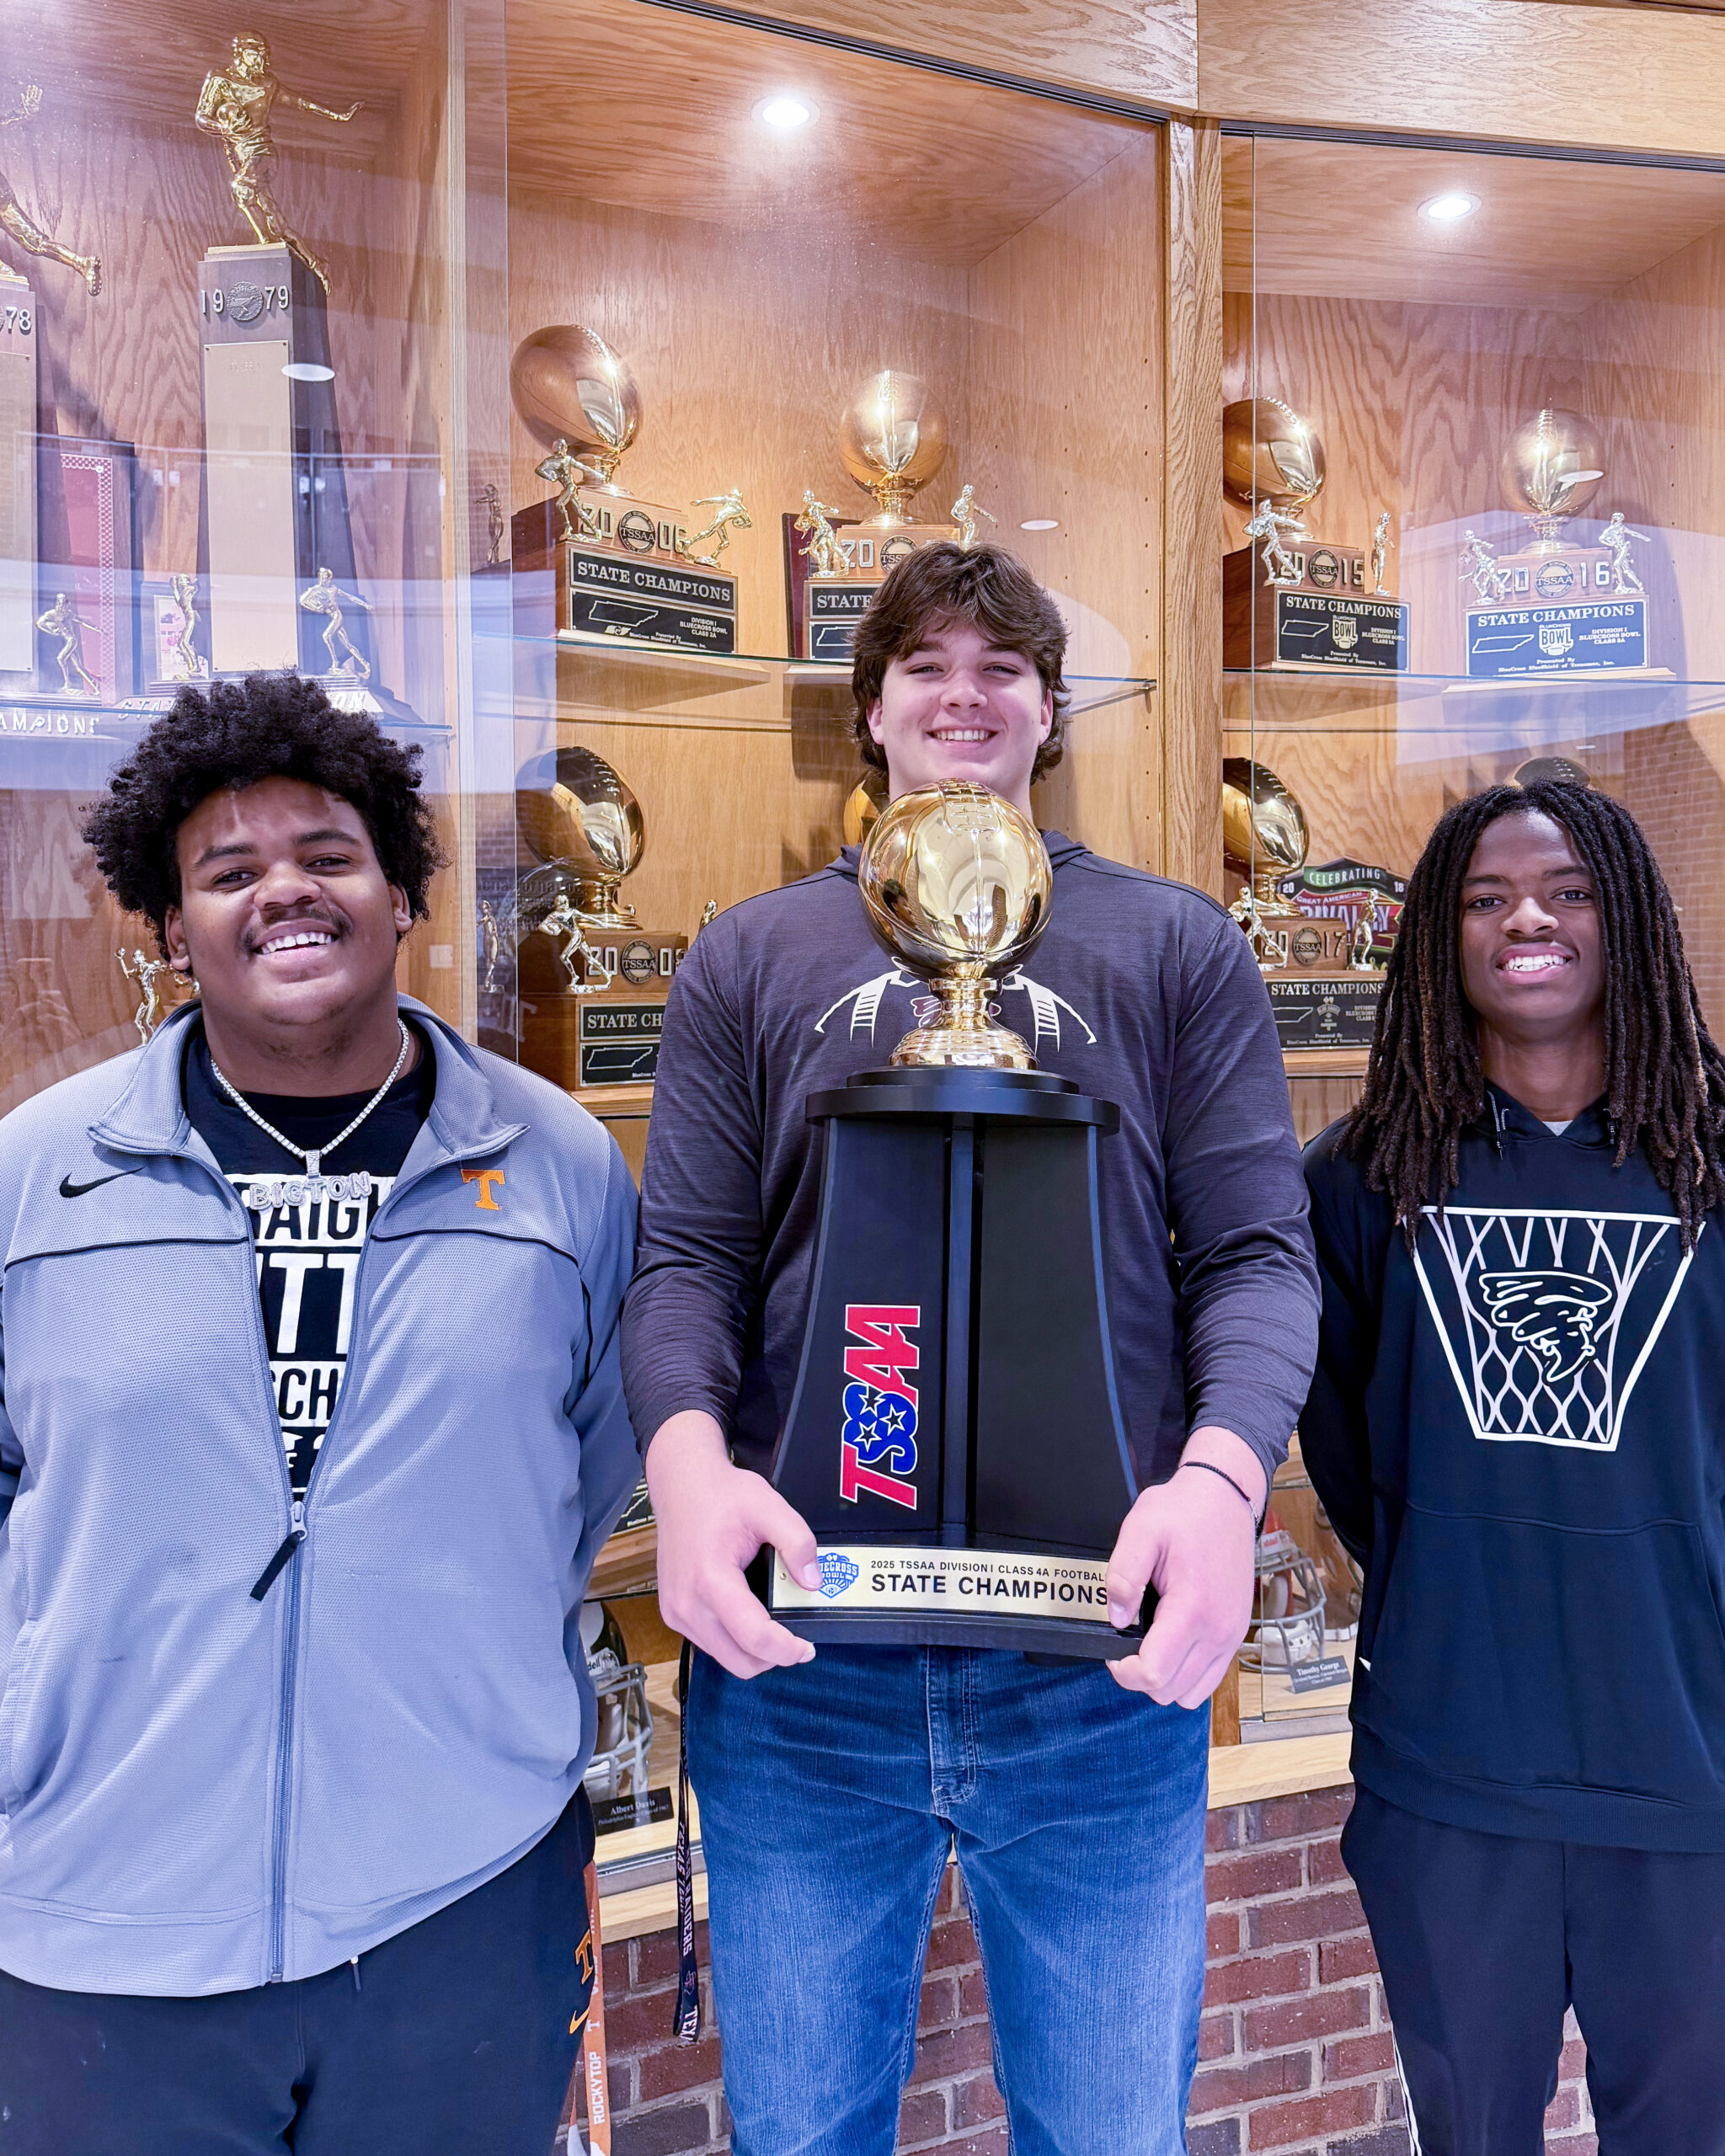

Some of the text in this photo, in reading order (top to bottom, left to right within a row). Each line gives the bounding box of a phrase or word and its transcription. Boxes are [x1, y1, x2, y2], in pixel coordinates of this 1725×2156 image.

[200, 286, 289, 313] 19 79
[5, 306, 32, 331] 78
[621, 527, 655, 542] TSSAA
[1311, 565, 1338, 575] TSSAA
[1342, 558, 1365, 586] 15
[1537, 575, 1573, 586] TSSAA
[1579, 561, 1610, 588] 16
[577, 561, 730, 602] STATE CHAMPIONS
[1286, 596, 1402, 619] STATE CHAMPIONS
[1477, 604, 1635, 627] STATE CHAMPIONS
[679, 621, 713, 632] BLUECROSS
[691, 616, 714, 627] DIVISION
[1334, 621, 1357, 638] BOWL
[692, 628, 708, 638] CLASS
[1541, 628, 1571, 645] BOWL
[1578, 632, 1621, 641] BLUECROSS
[1308, 867, 1381, 885] CELEBRATING
[1282, 881, 1404, 894] 20 18
[1297, 892, 1363, 906] GREAT AMERICAN
[1295, 942, 1322, 952] TSSAA
[1325, 931, 1347, 957] 17
[623, 959, 655, 969] TSSAA
[1271, 984, 1310, 995] STATE
[587, 1014, 638, 1029] STATE
[460, 1168, 505, 1210] T
[271, 1368, 339, 1421] CH
[840, 1305, 921, 1510] TSSAA
[871, 1560, 1106, 1582] 2025 TSSAA DIVISION I CLASS 4A FOOTBAL
[871, 1573, 1108, 1605] STATE CHAMPIONS
[1296, 1662, 1339, 1677] Timothy George
[610, 1803, 634, 1816] Albert
